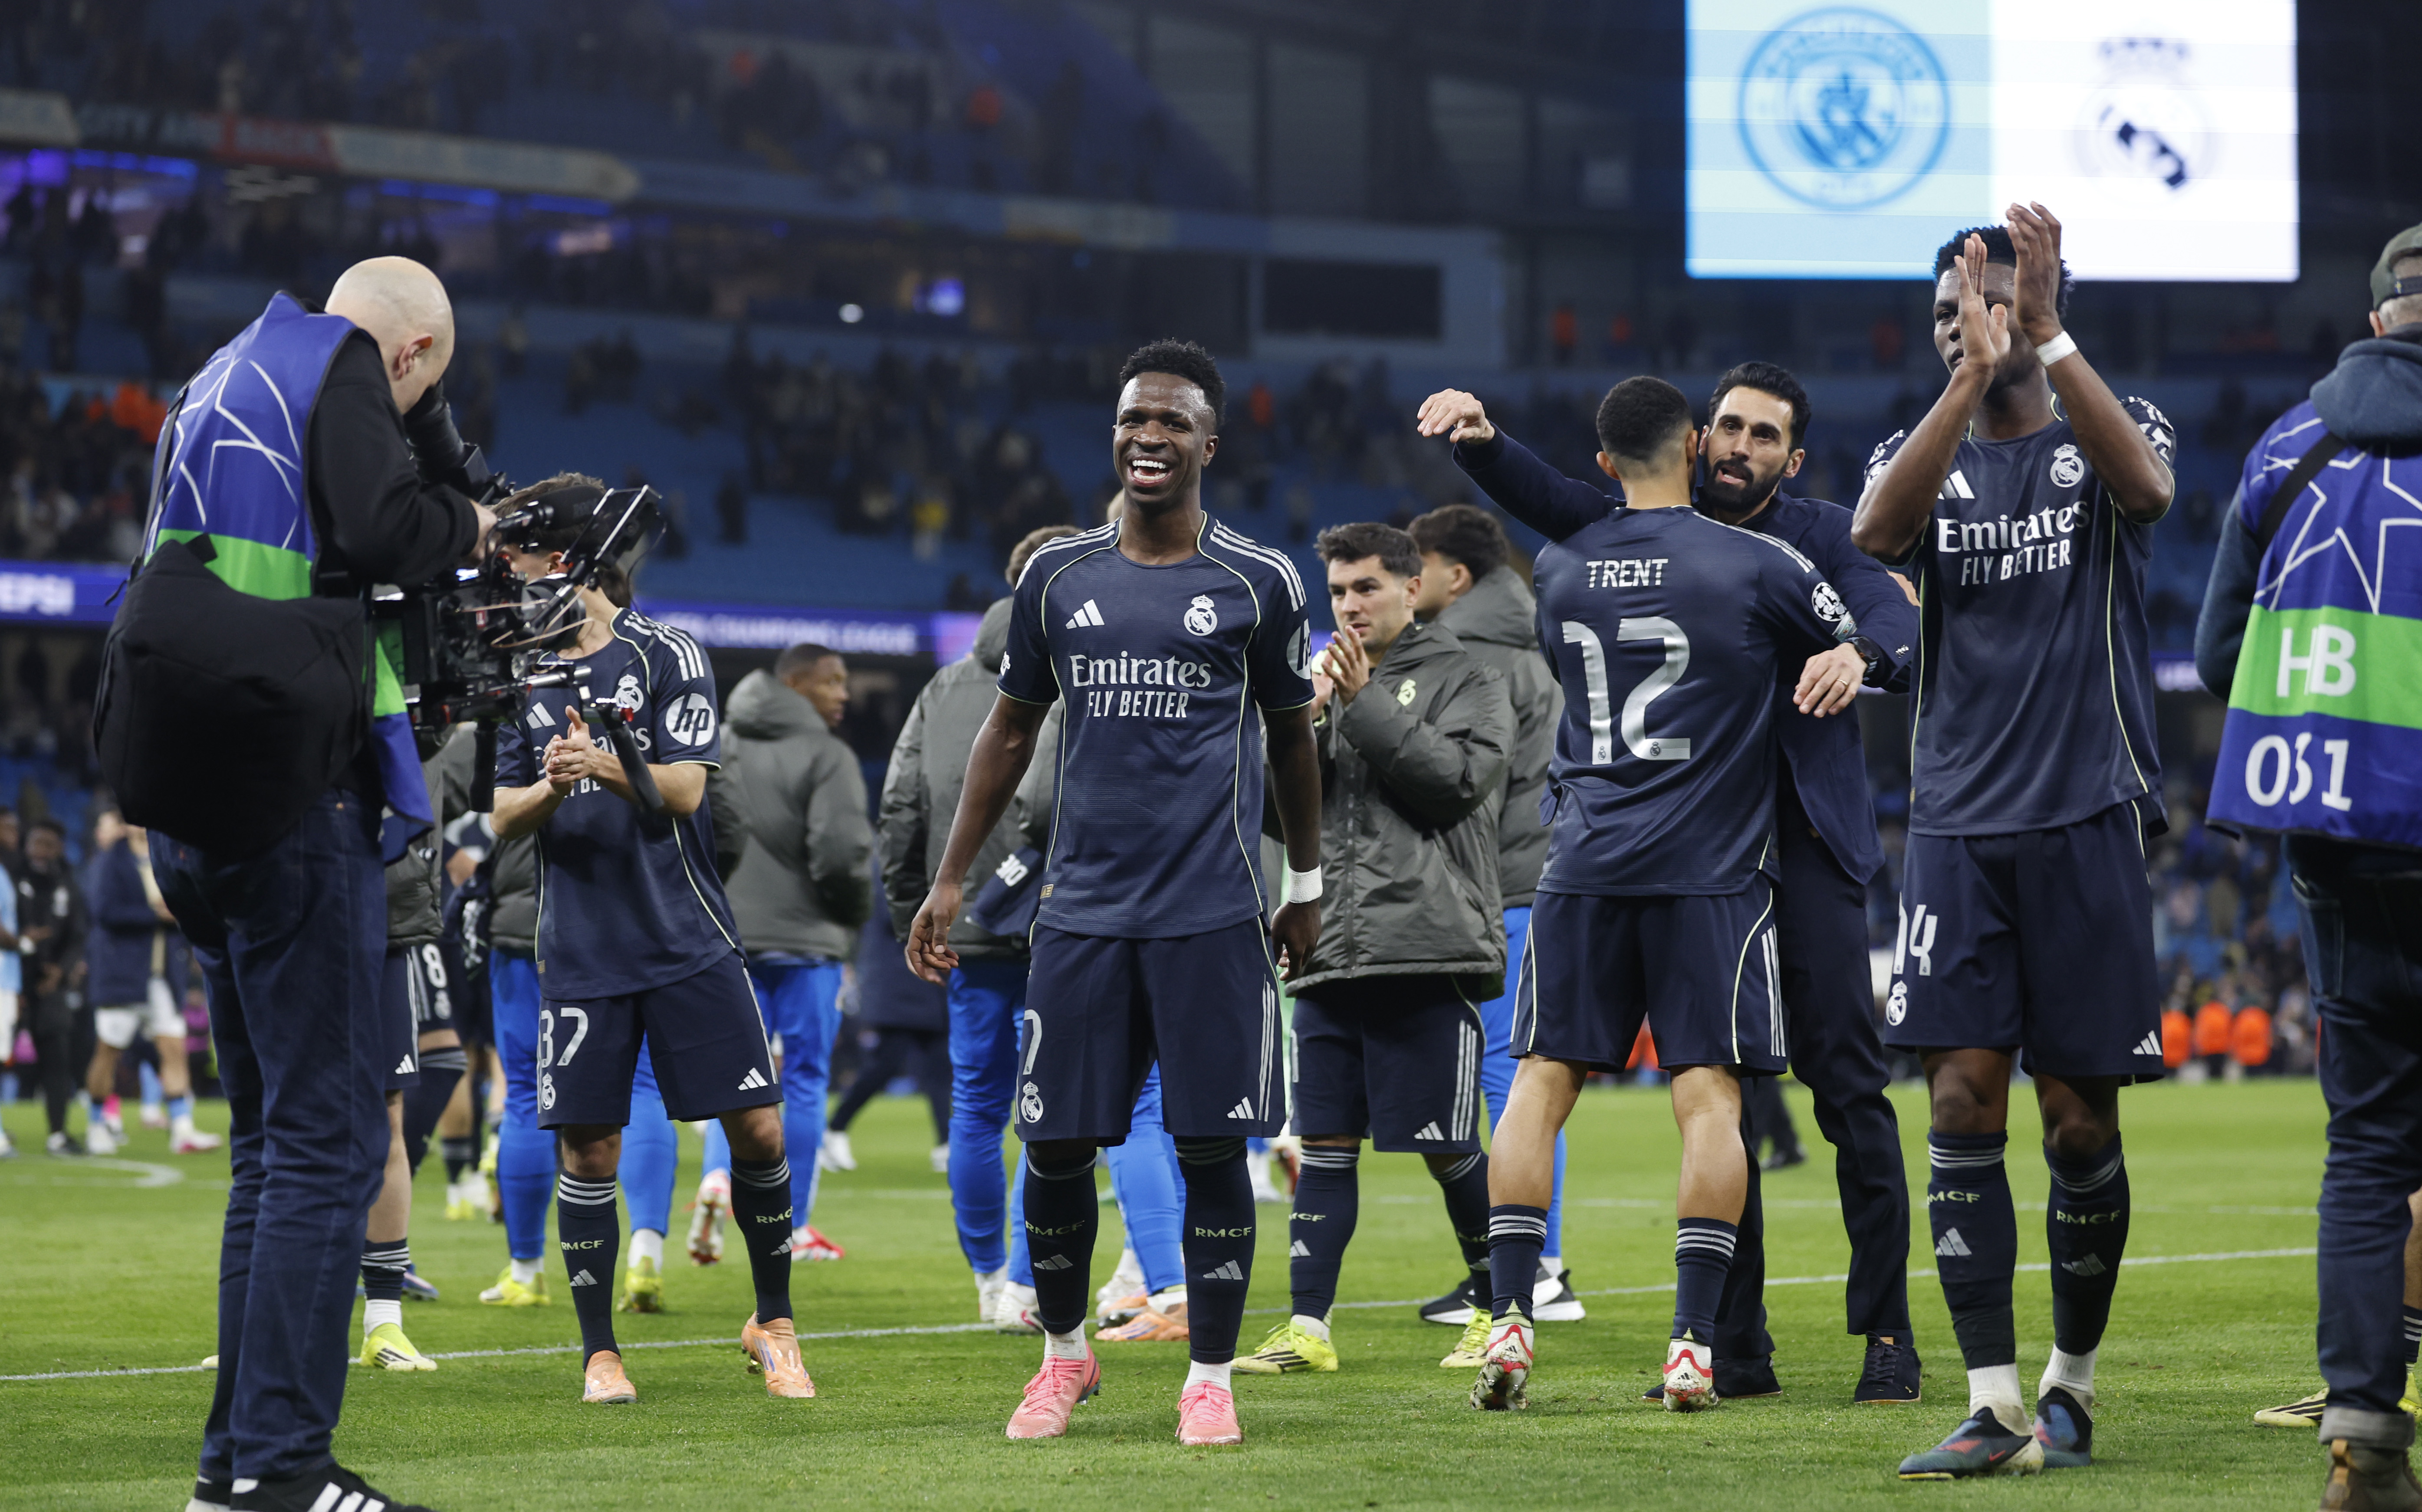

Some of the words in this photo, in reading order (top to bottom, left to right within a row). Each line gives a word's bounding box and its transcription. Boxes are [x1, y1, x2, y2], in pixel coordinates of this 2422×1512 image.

[1937, 500, 2090, 553] Emirates
[1586, 558, 1669, 588] TRENT
[1961, 556, 1995, 586] FLY
[2000, 538, 2071, 581] BETTER
[1069, 650, 1212, 688] Emirates
[2277, 623, 2356, 698] HB
[1087, 691, 1114, 718] FLY
[1118, 690, 1189, 718] BETTER
[1562, 617, 1691, 765] 12
[671, 693, 711, 746] hp
[1893, 892, 1938, 976] 14
[422, 943, 447, 988] 8
[541, 1007, 588, 1068] 37
[1022, 1009, 1042, 1076] 7
[756, 1206, 793, 1223] RMC
[1025, 1220, 1085, 1236] RMCF
[1195, 1227, 1252, 1237] RMCF
[1288, 1212, 1326, 1222] MCF
[2056, 1209, 2120, 1225] RMCF
[561, 1240, 604, 1250] RMCF
